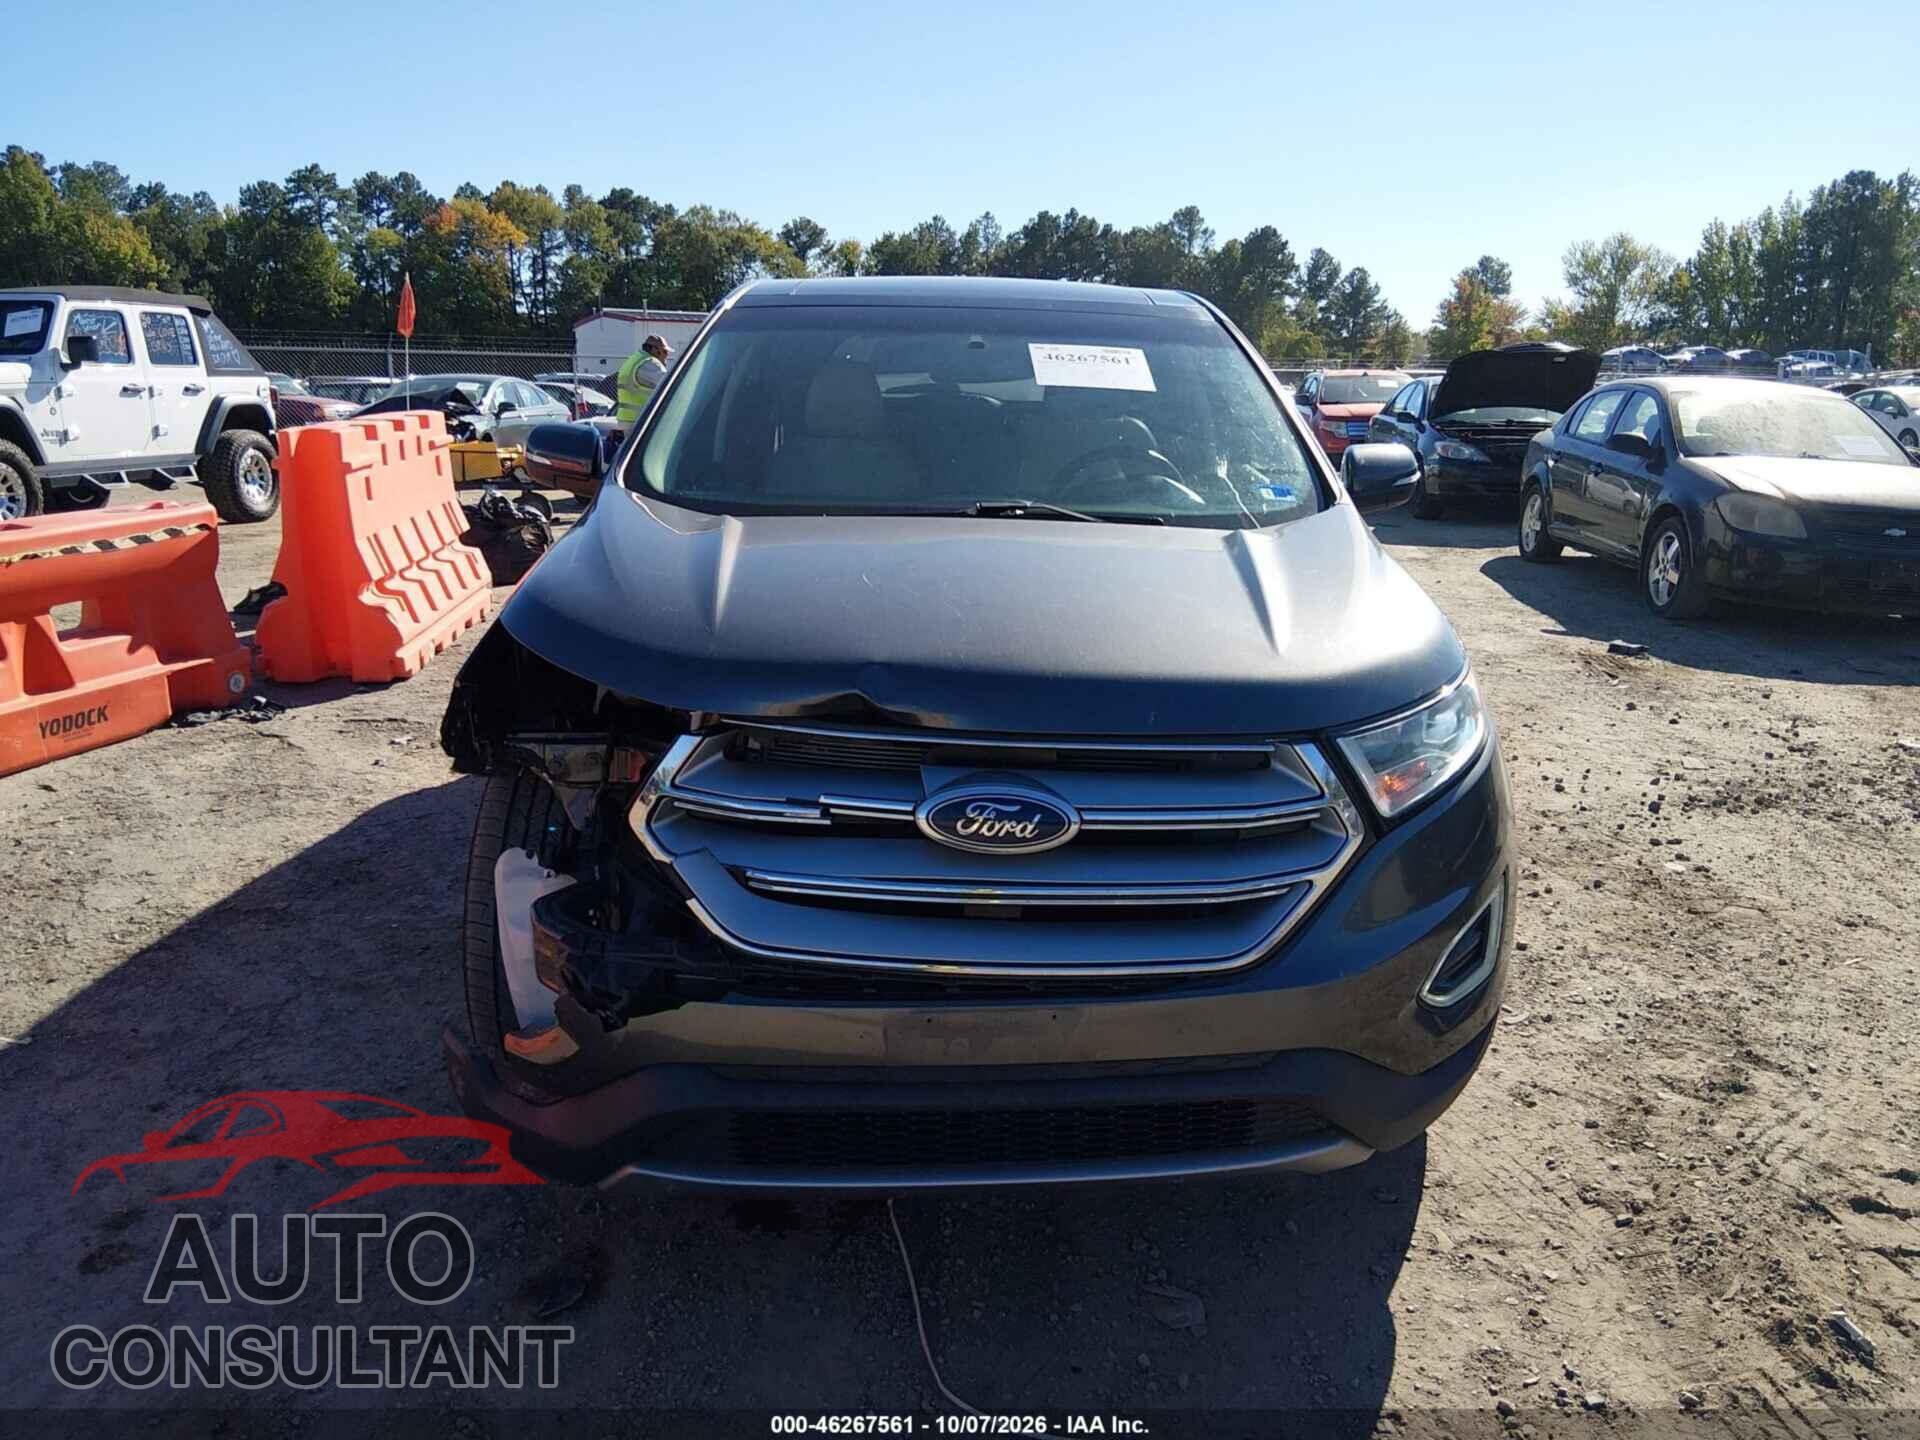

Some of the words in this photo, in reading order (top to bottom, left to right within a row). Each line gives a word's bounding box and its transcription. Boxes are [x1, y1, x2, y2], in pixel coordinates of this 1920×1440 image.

[1043, 353, 1131, 365] 46267561
[39, 704, 109, 740] YODOCK
[956, 802, 1042, 838] Ford
